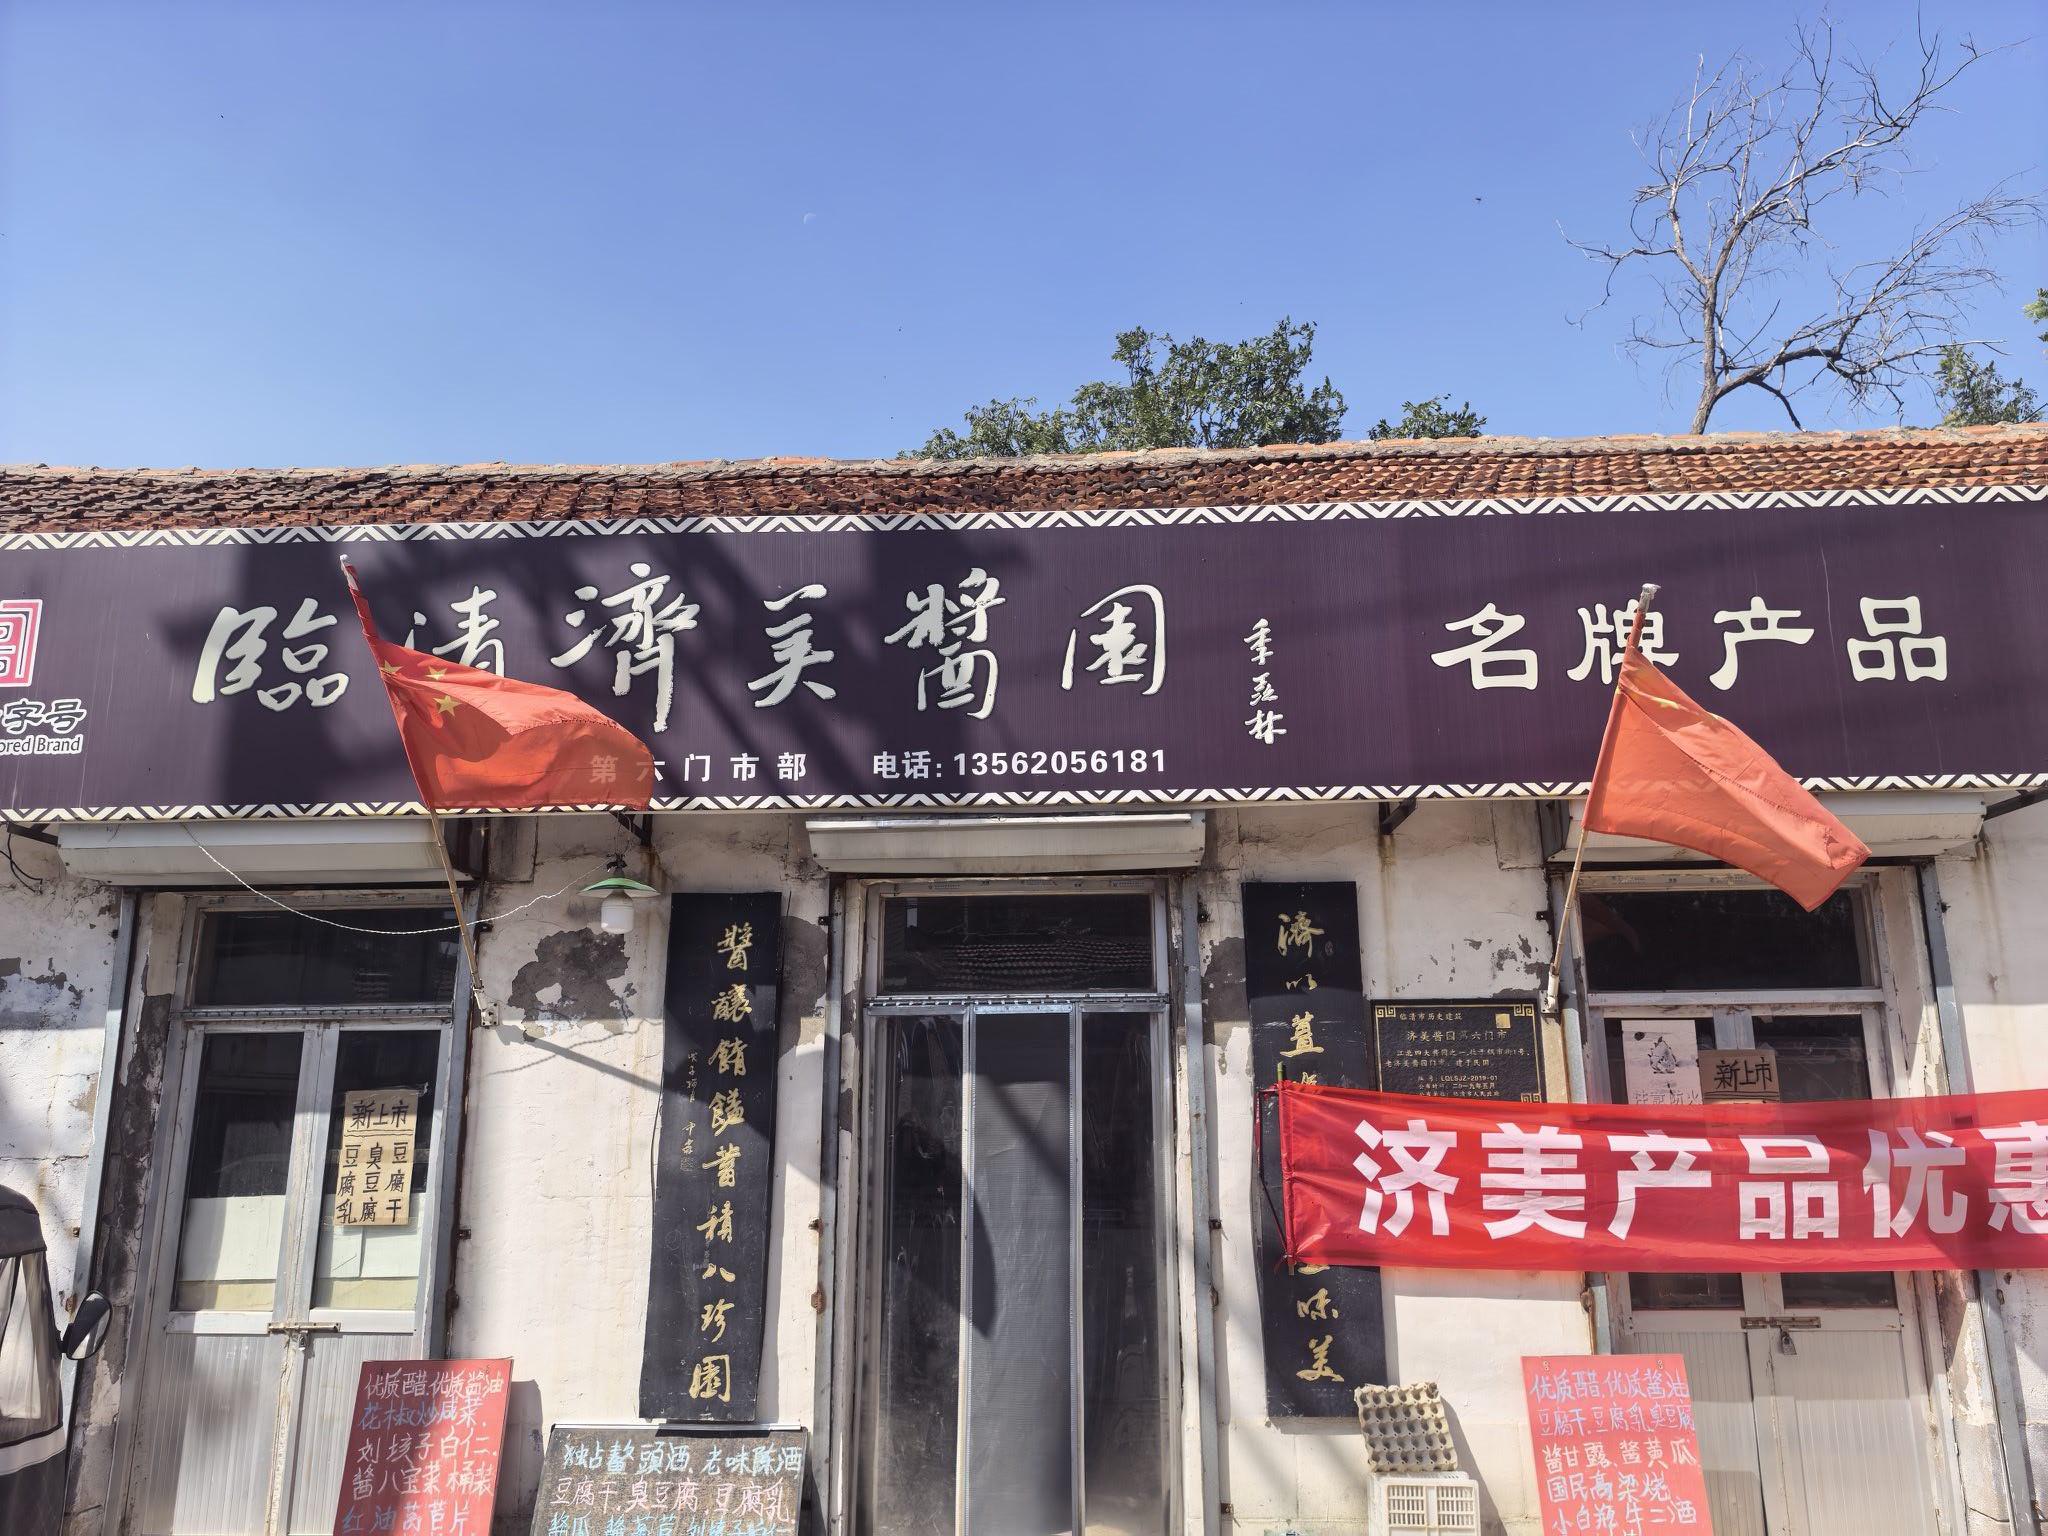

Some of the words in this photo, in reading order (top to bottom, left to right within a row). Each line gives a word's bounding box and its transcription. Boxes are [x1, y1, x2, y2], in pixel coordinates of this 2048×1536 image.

[1431, 595, 1949, 690] 名牌产品
[36, 735, 82, 754] Brand
[588, 751, 808, 784] 第六门市部
[1714, 1057, 1774, 1092] 新上市
[350, 1100, 409, 1130] 新上市
[336, 1144, 361, 1224] 豆腐乳
[359, 1141, 383, 1222] 臭豆腐
[384, 1142, 409, 1223] 豆腐干
[1353, 1119, 2048, 1242] 济美产品优惠
